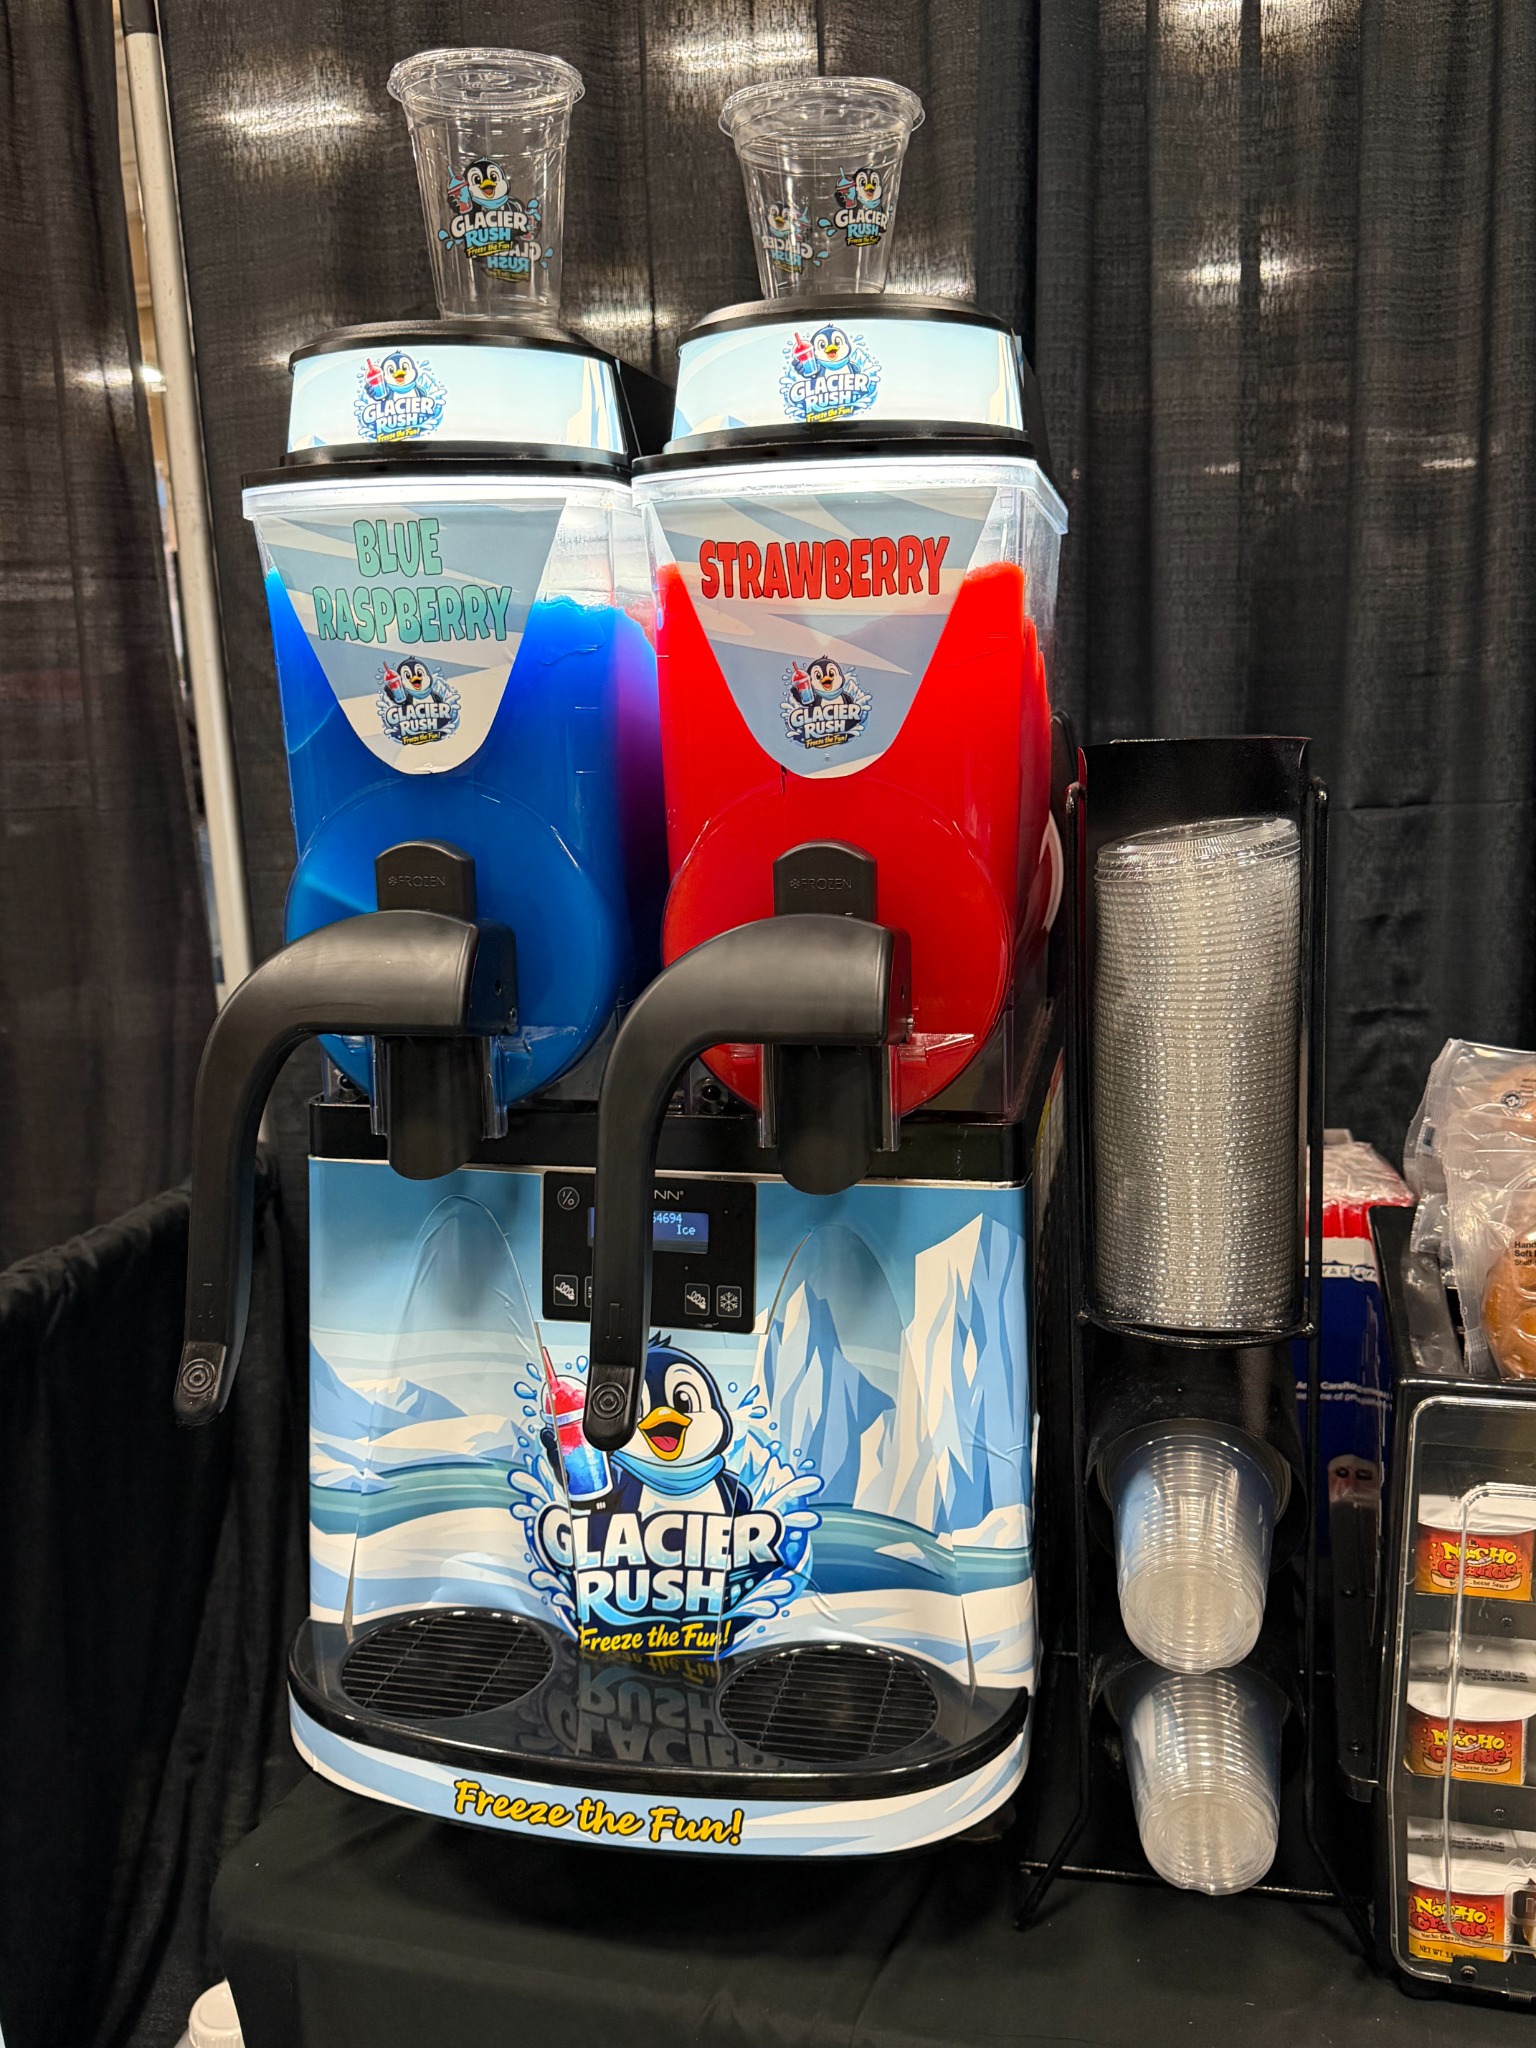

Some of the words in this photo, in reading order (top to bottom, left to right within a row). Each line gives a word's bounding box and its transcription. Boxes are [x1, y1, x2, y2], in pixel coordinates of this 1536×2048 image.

[451, 211, 528, 238] GLACIER
[835, 209, 888, 230] GLACIER
[848, 224, 879, 238] RUSH
[465, 228, 511, 248] RUSH
[789, 374, 868, 402] GLACIER
[362, 396, 434, 423] GLACIER
[805, 390, 852, 413] RUSH
[376, 413, 418, 434] RUSH
[353, 518, 443, 577] BLUE
[699, 535, 950, 600] STRAWBERRY
[312, 585, 513, 644] RASPBERRY
[386, 702, 452, 725] GLACIER
[790, 703, 862, 728] GLACIER
[400, 718, 438, 737] RUSH
[804, 719, 846, 740] RUSH
[399, 875, 446, 887] FROZEN
[801, 878, 852, 889] FROZEN
[676, 1224, 696, 1235] Ice
[541, 1507, 780, 1570] GLACIER
[1438, 1559, 1518, 1579] Gande
[578, 1570, 724, 1623] RUSH
[578, 1625, 644, 1652] Freeze
[646, 1624, 681, 1648] the
[681, 1620, 732, 1648] Fun!
[1429, 1746, 1507, 1764] Gande
[454, 1778, 574, 1828] Freeze
[576, 1797, 645, 1836] the
[649, 1806, 744, 1845] Fun!
[1419, 1945, 1431, 1954] NET
